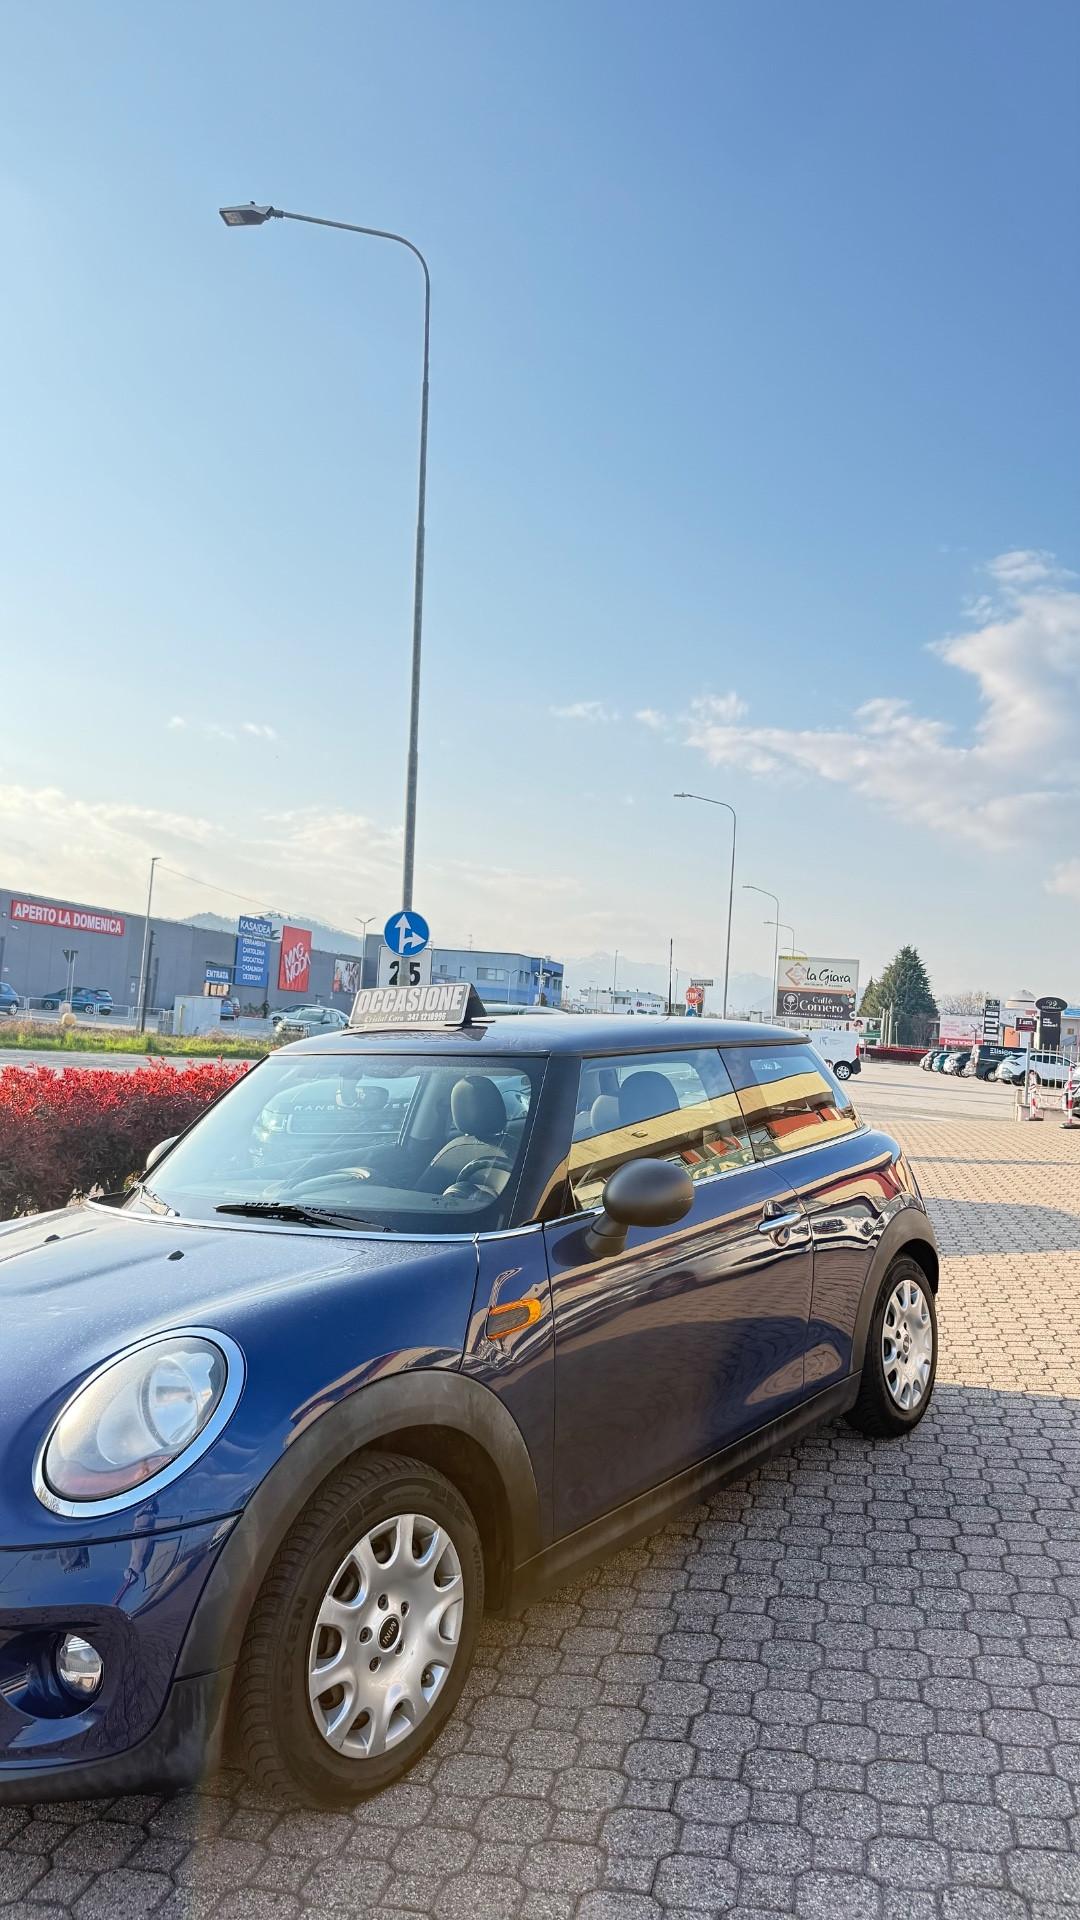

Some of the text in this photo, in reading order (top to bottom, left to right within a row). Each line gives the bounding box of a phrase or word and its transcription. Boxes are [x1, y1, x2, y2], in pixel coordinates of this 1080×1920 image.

[14, 902, 122, 933] APERTO LA DOMENICA
[206, 969, 229, 979] ENTRATA
[806, 967, 851, 985] la Giara
[356, 985, 465, 1014] OCCASIONE
[382, 1621, 397, 1645] MINI
